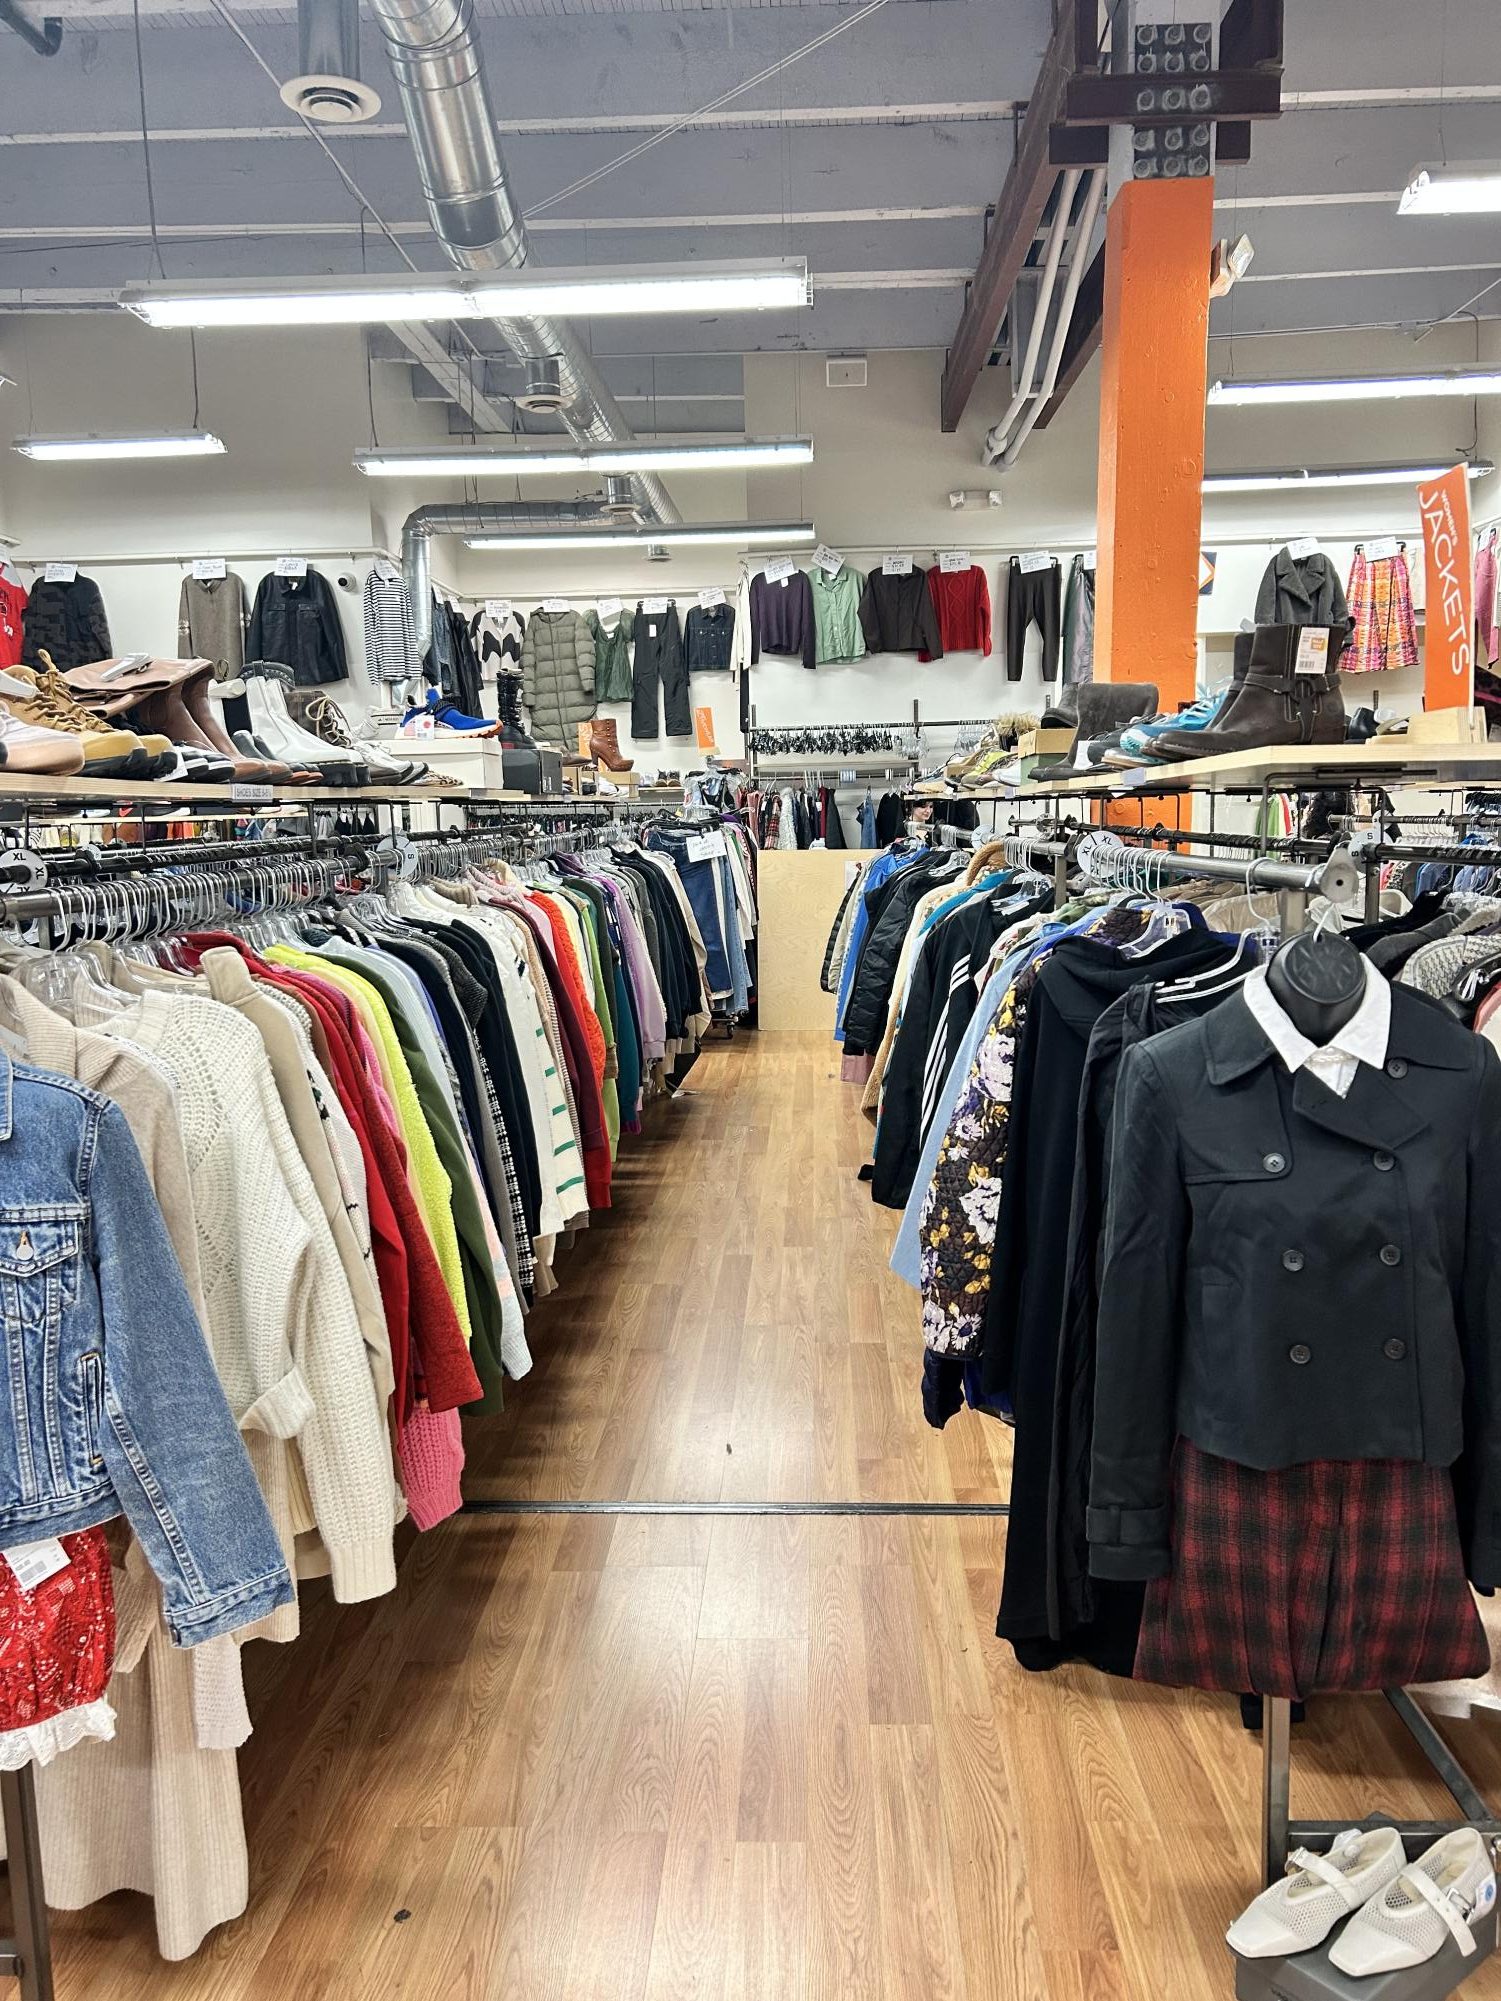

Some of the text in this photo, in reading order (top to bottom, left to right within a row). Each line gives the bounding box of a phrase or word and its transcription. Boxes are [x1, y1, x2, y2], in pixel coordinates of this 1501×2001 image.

[1419, 490, 1470, 675] JACKETS
[1101, 835, 1112, 846] XL
[1367, 832, 1374, 840] S
[1082, 845, 1093, 856] XL
[13, 852, 26, 861] XL
[35, 866, 44, 880] XL
